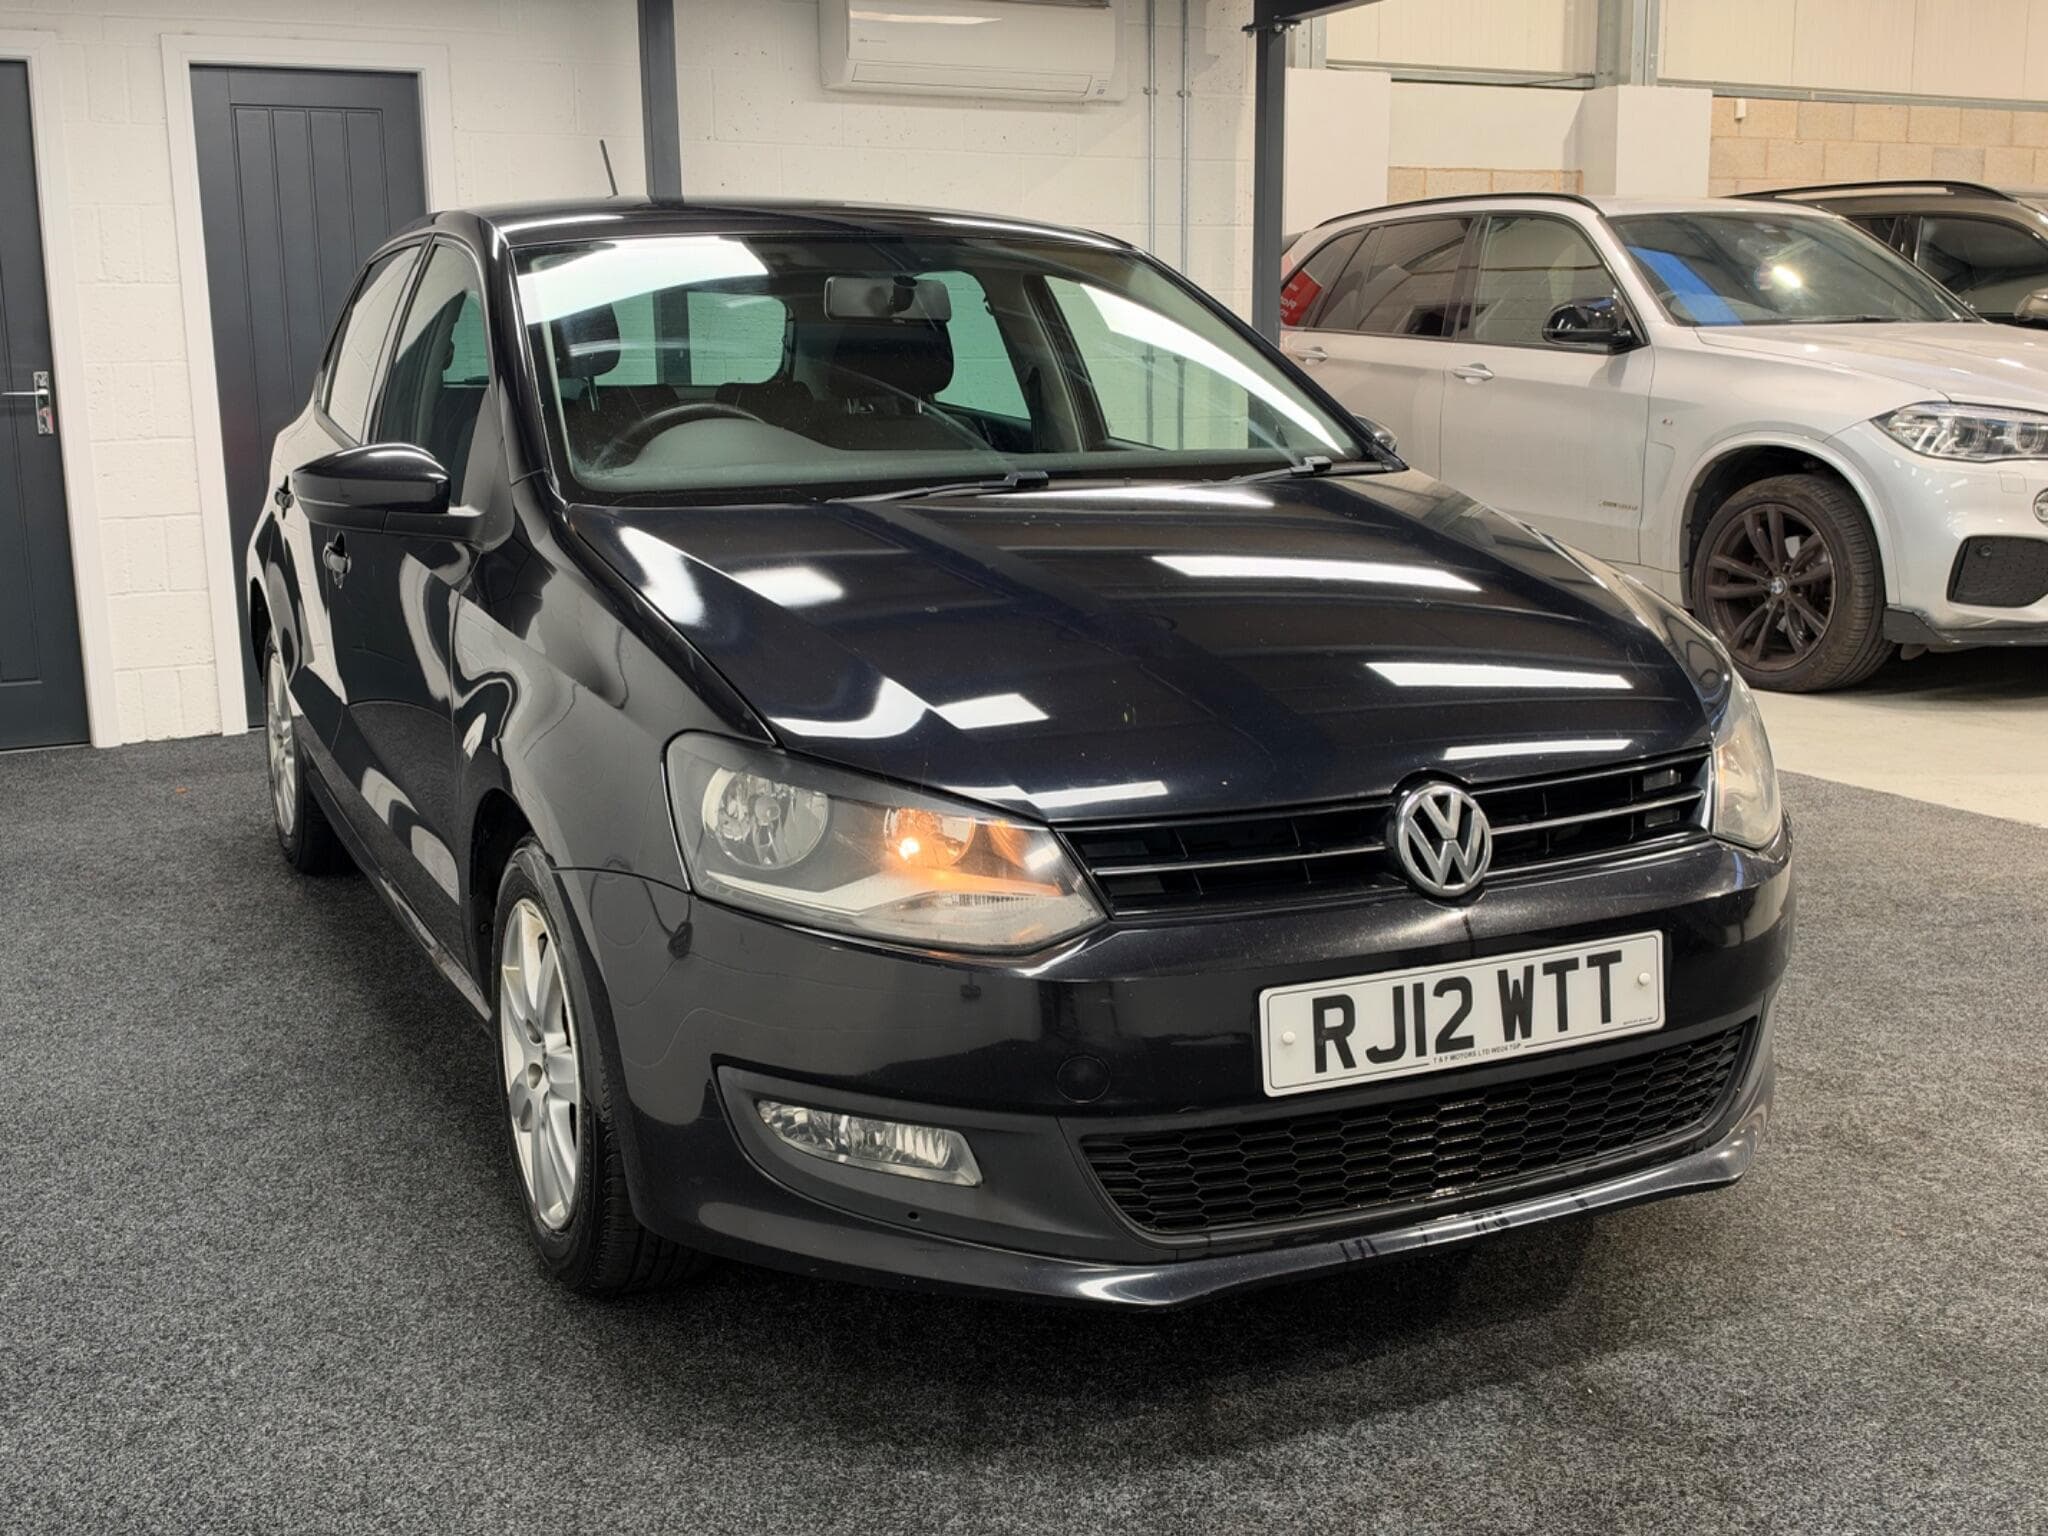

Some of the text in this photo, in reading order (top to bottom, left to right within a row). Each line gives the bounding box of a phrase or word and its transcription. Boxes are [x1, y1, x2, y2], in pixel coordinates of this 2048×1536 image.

[1312, 950, 1622, 1074] RJ12 WTT
[1450, 1050, 1476, 1061] MOTORS
[1478, 1047, 1490, 1057] LTD
